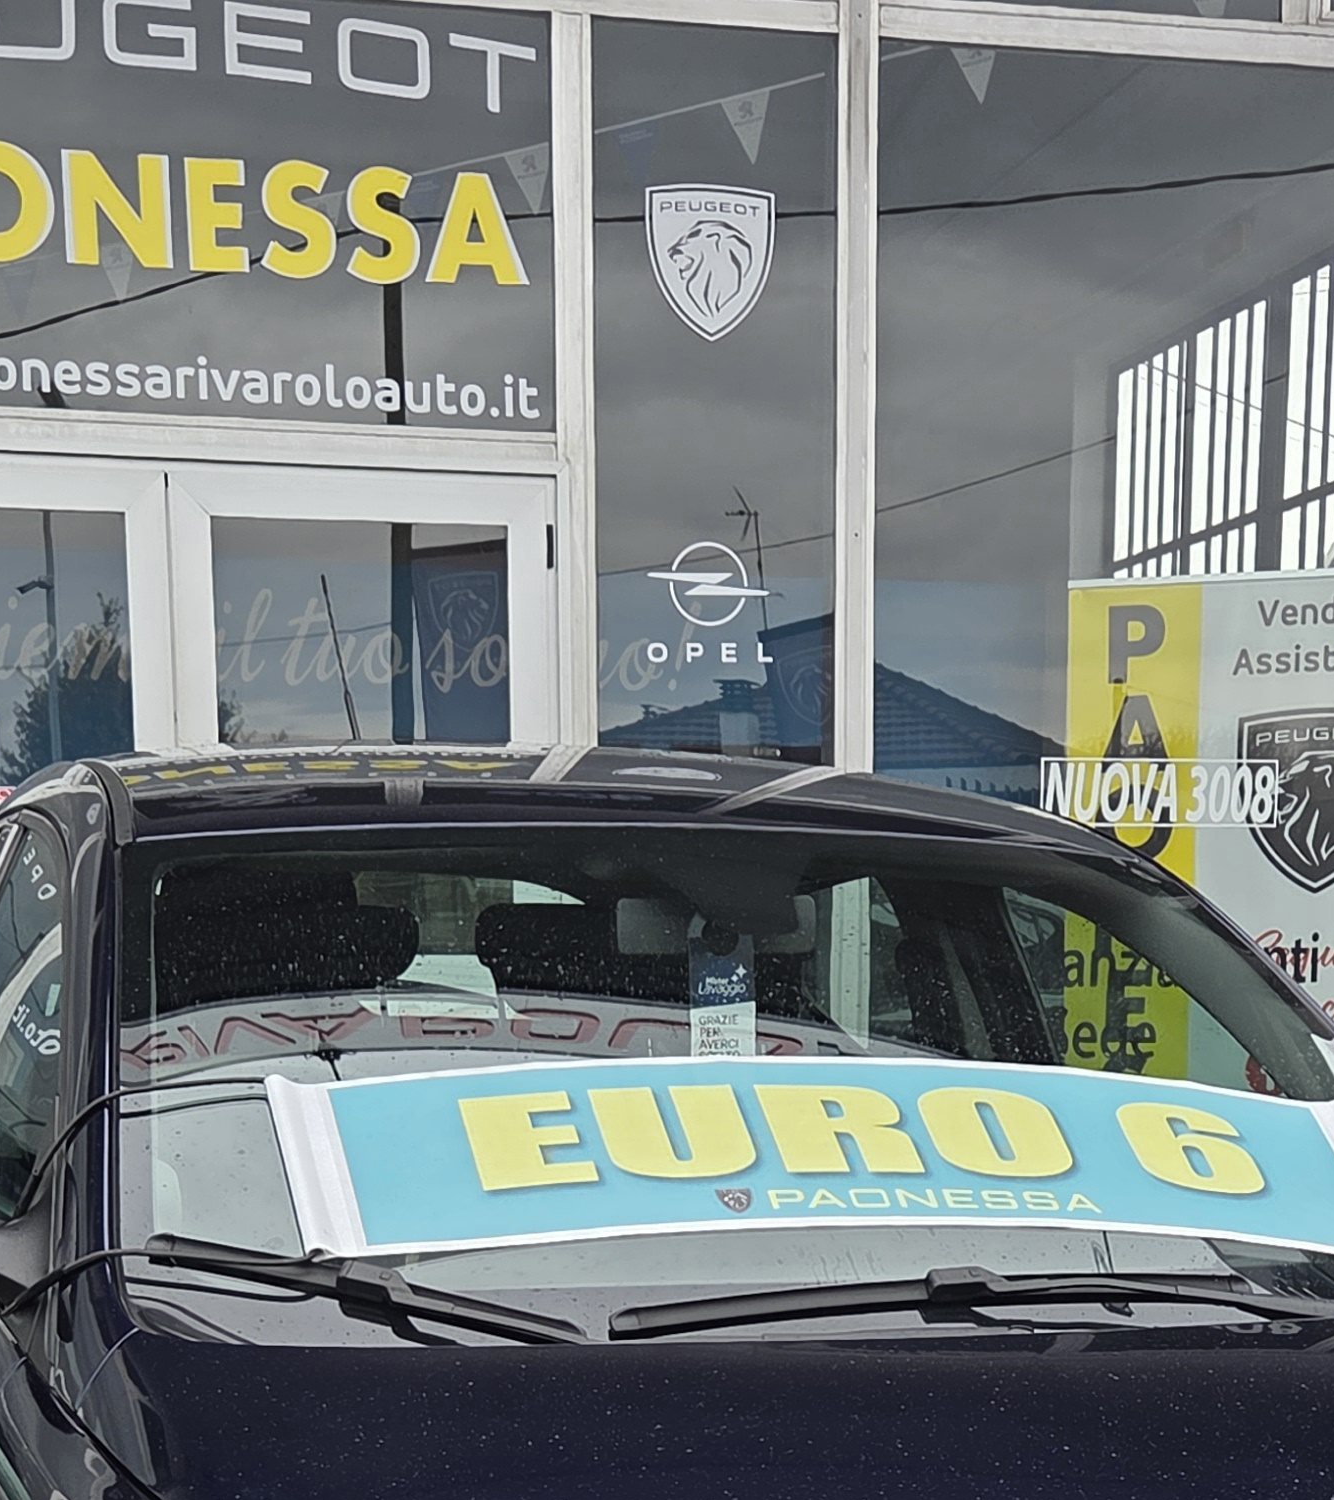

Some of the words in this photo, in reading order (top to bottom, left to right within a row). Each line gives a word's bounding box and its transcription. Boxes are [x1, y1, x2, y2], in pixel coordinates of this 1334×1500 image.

[659, 200, 761, 218] PEUGEOT
[646, 642, 774, 664] OPEL
[1044, 761, 1178, 824] NUOVA
[1185, 764, 1275, 824] 3008
[698, 1014, 740, 1027] GRAZIE
[698, 1039, 740, 1051] AVERCI
[458, 1084, 1074, 1192] EURO
[1115, 1101, 1267, 1195] 6
[767, 1188, 1102, 1214] PAONESSA
